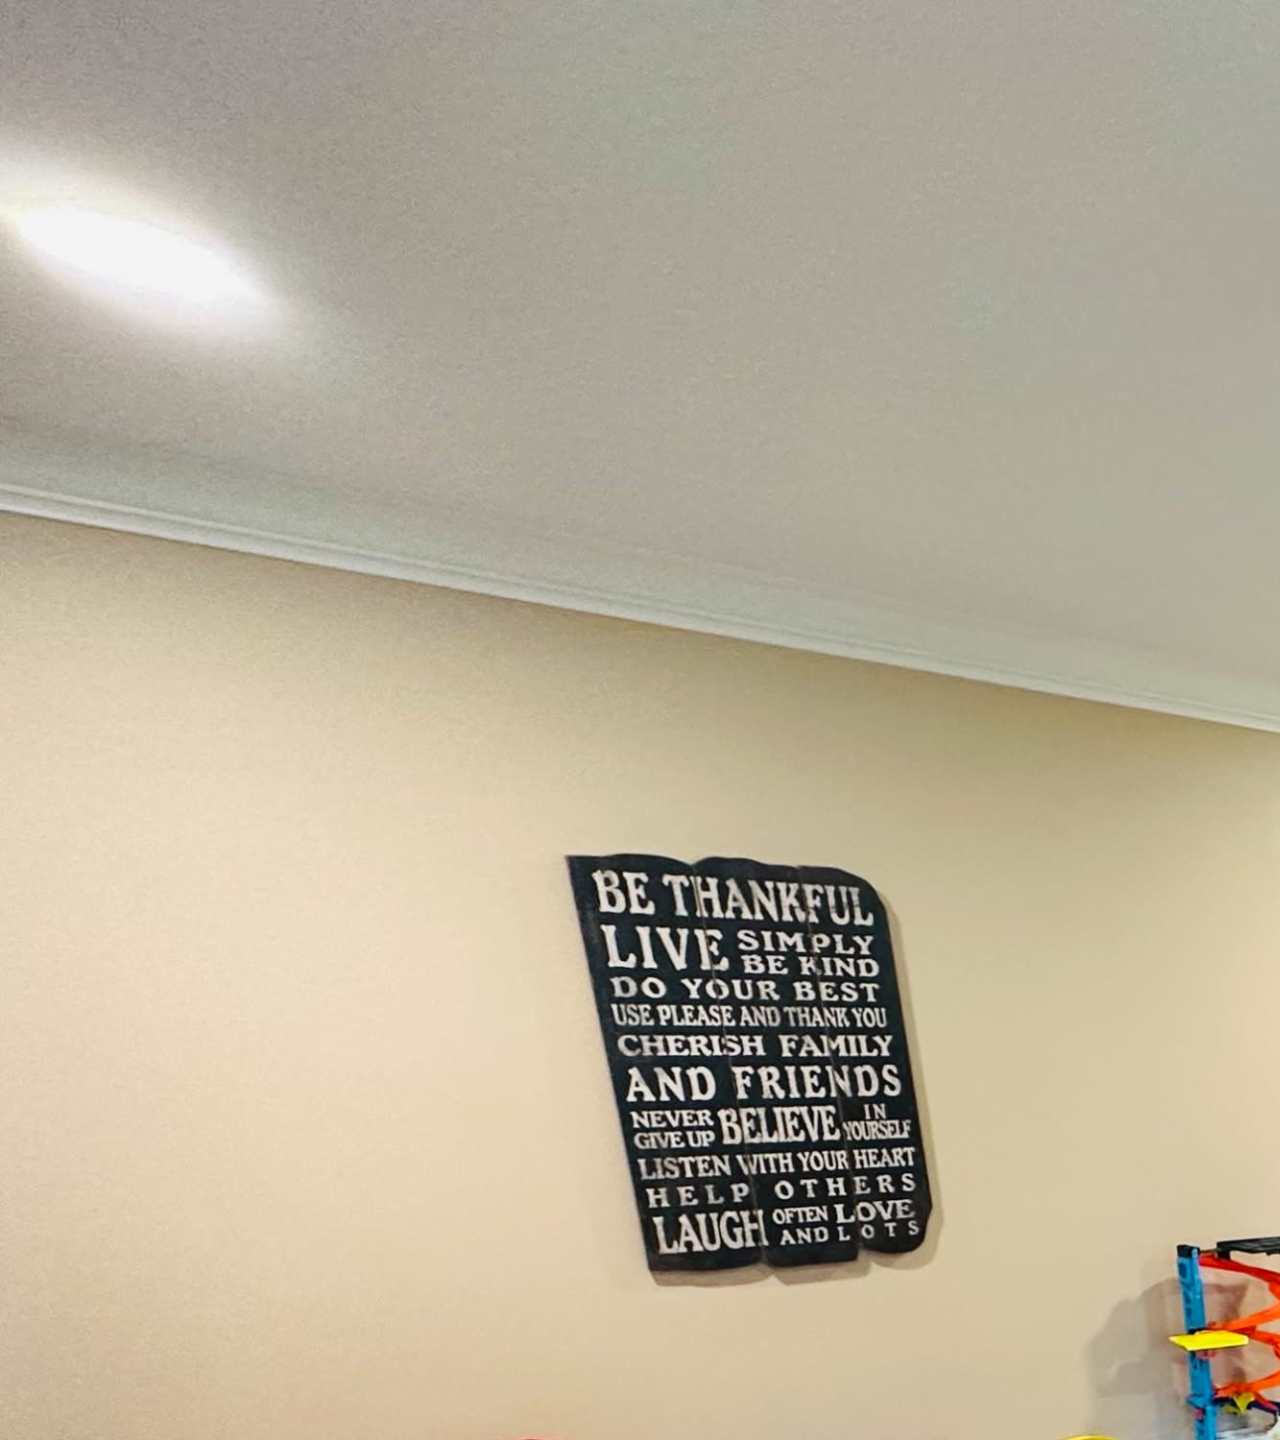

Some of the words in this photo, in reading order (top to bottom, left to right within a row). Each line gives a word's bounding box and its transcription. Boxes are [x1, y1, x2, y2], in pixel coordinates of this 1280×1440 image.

[593, 870, 654, 916] BE
[663, 874, 873, 925] THANKFUL
[601, 925, 729, 970] LIVE
[737, 930, 873, 955] SIMPLY
[743, 954, 788, 975] BE
[799, 956, 879, 978] KIND
[611, 977, 666, 998] DO
[681, 979, 780, 1000] YOUR
[793, 981, 879, 1002] BEST
[611, 1004, 654, 1026] USE
[659, 1004, 736, 1027] PLEASE
[740, 1005, 780, 1027] AND
[784, 1007, 850, 1028] THANK
[852, 1008, 887, 1028] YOU
[617, 1035, 766, 1057] CHERISH
[779, 1034, 893, 1057] FAMILY
[626, 1065, 716, 1102] AND
[732, 1064, 900, 1099] FRIENDS
[631, 1110, 715, 1128] NEVER
[864, 1104, 887, 1120] IN
[717, 1105, 840, 1145] BELIEVE
[843, 1120, 910, 1141] YOURSELF
[633, 1131, 686, 1150] GIVE
[688, 1132, 715, 1148] UP
[638, 1155, 730, 1180] LISTEN
[737, 1153, 794, 1175] WITH
[797, 1150, 848, 1172] YOUR
[855, 1146, 915, 1168] HEART
[647, 1184, 750, 1208] HELP
[774, 1173, 915, 1200] OTHERS
[773, 1205, 828, 1225] OFTEN
[835, 1199, 915, 1223] LOVE
[652, 1209, 768, 1255] LAUGH
[780, 1226, 829, 1245] AND
[838, 1221, 919, 1241] LOTS
